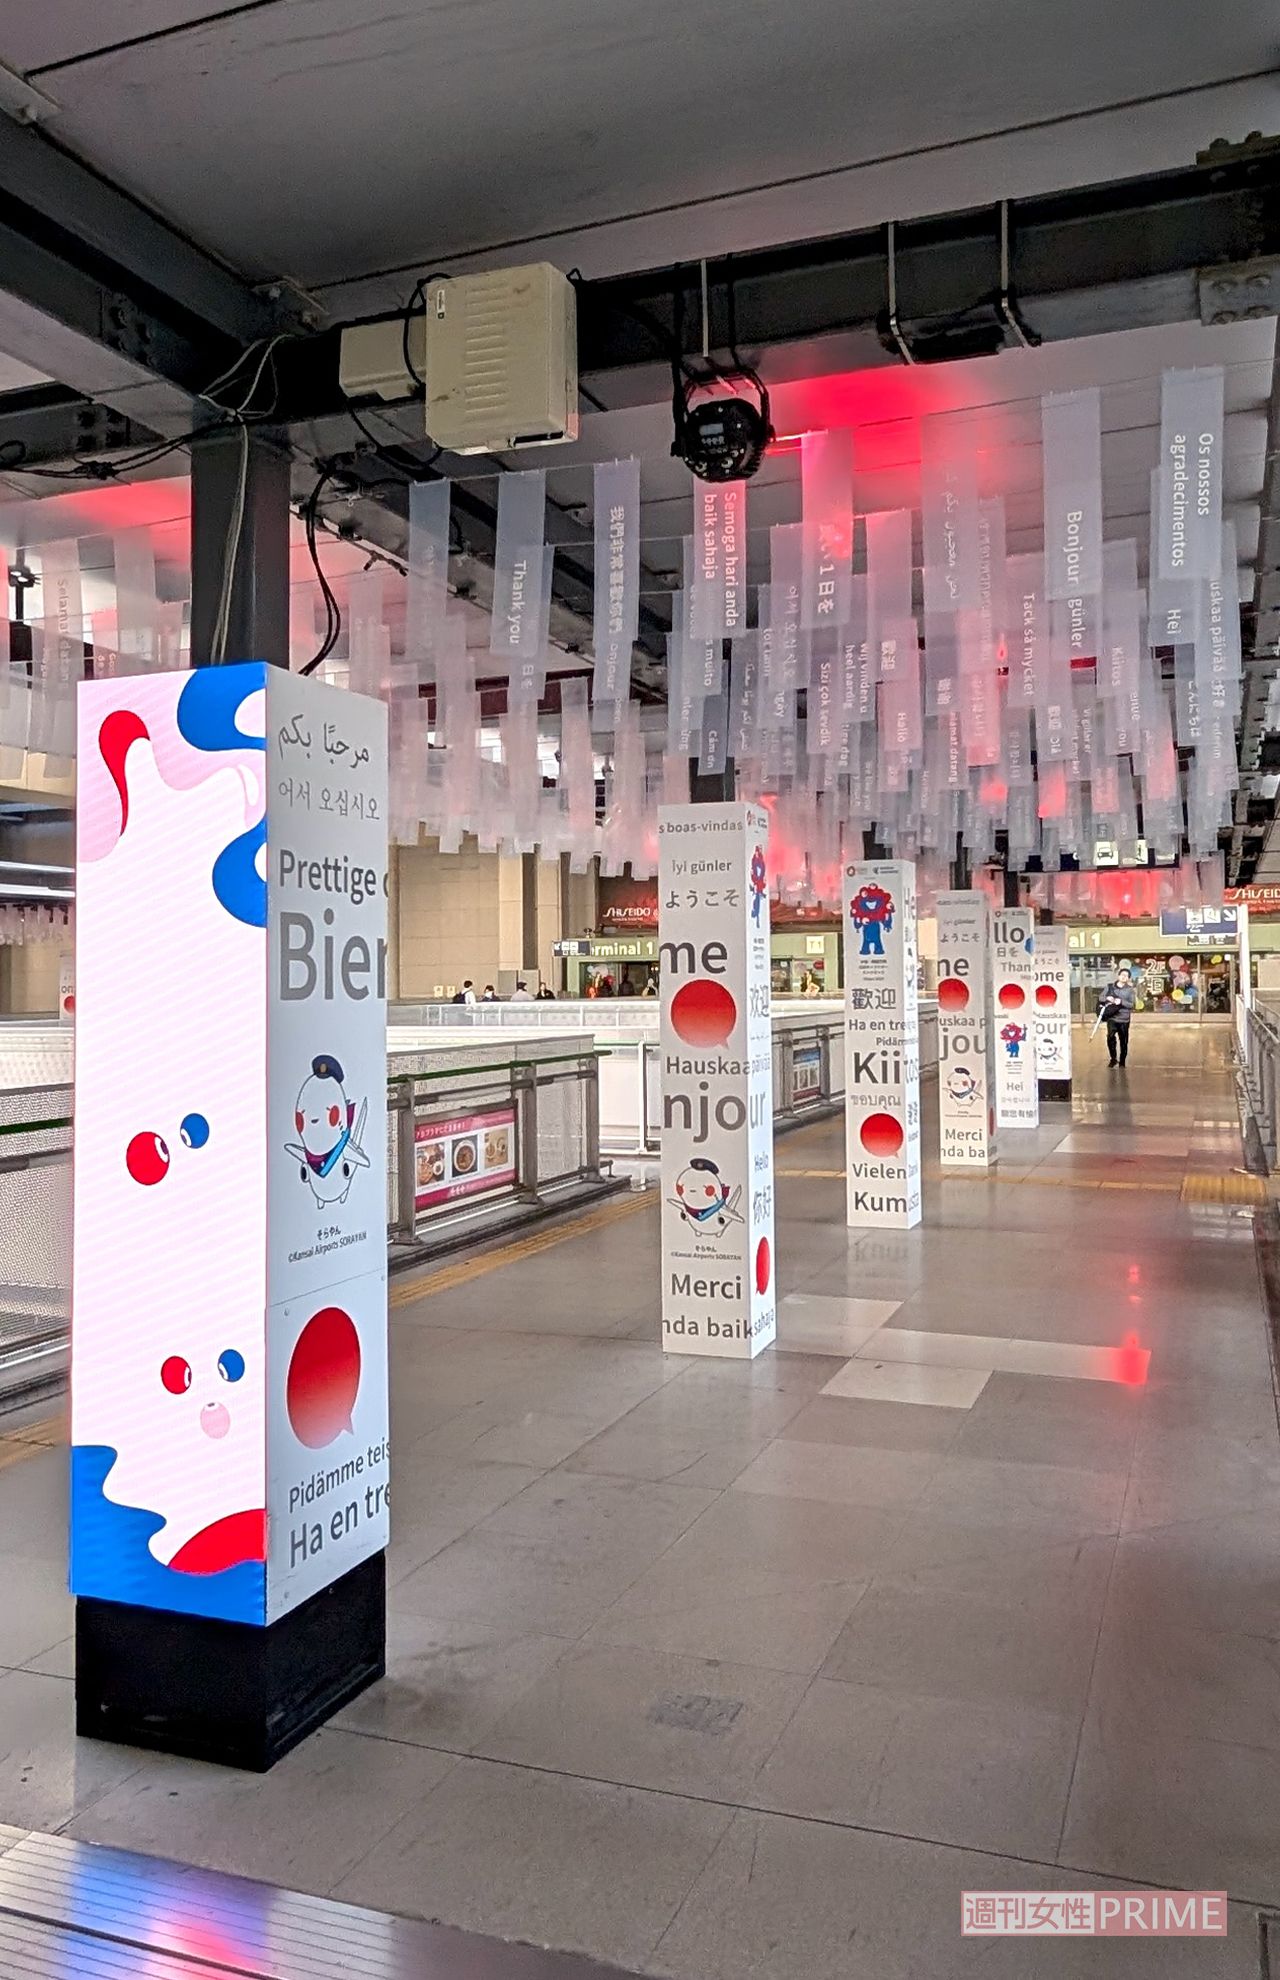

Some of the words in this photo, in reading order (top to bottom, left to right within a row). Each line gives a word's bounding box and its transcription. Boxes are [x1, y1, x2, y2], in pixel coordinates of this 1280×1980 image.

[1198, 432, 1214, 455] Os
[1171, 434, 1188, 567] agradecimentos
[1197, 459, 1212, 515] nossos
[703, 493, 717, 527] baik
[721, 492, 737, 551] Semoga
[702, 530, 718, 580] sahaja
[1063, 510, 1083, 585] Bonjour
[511, 559, 528, 610] Thank
[725, 553, 738, 587] hari
[725, 592, 738, 627] anda
[1023, 593, 1036, 626] Tack
[1068, 598, 1086, 649] günler
[1167, 609, 1182, 635] Hei
[507, 612, 521, 645] you
[278, 713, 312, 761] بكم
[323, 721, 369, 768] مرحبًا
[279, 777, 312, 811] 어서
[319, 787, 380, 820] 오십시오
[666, 820, 743, 833] boas-vindas
[280, 849, 377, 905] Prettige
[690, 860, 732, 875] günler
[603, 907, 650, 917] SHISEIDO
[665, 888, 740, 908] ようこそ
[646, 942, 653, 954] 1
[940, 932, 980, 943] ようこそ
[994, 921, 1024, 943] llo
[1091, 932, 1101, 947] 1
[660, 941, 728, 974] me
[851, 988, 897, 1010] 歡迎
[849, 1019, 866, 1031] Ha
[870, 1021, 885, 1031] en
[945, 1129, 982, 1141] Merci
[968, 1146, 985, 1158] ba
[852, 1163, 907, 1179] Vielen
[854, 1192, 907, 1213] Kum
[671, 1273, 742, 1300] Merci
[289, 1454, 364, 1513] Pidämme
[290, 1522, 323, 1568] Ha
[330, 1500, 358, 1541] en
